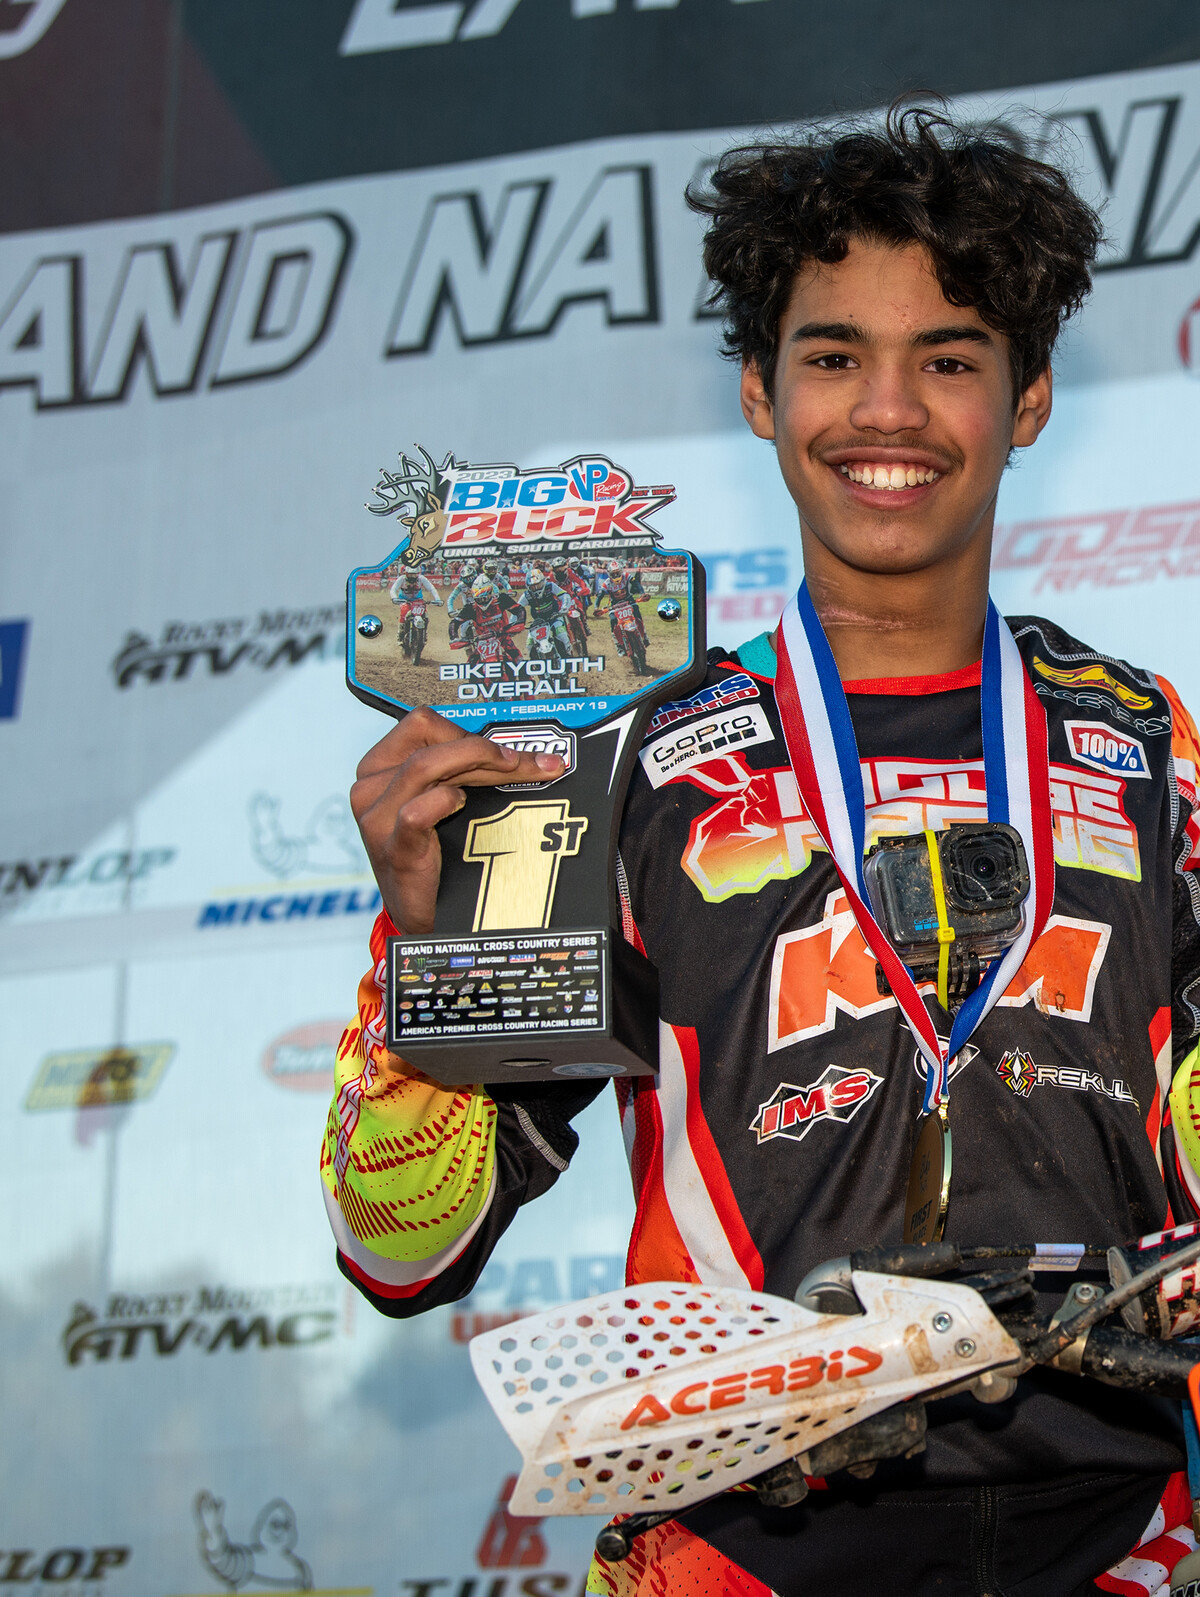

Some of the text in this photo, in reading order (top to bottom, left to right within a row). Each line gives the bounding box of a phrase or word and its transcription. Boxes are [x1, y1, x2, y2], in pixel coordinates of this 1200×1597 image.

[456, 470, 513, 482] 2023
[570, 463, 609, 502] VP
[447, 476, 569, 512] BIG
[444, 502, 652, 544] BUCK
[442, 537, 654, 558] UNION, SOUTH CAROLINA
[535, 626, 548, 641] 3
[438, 656, 604, 681] BIKE YOUTH
[457, 678, 587, 700] OVERALL
[436, 701, 608, 718] ROUND 1 FEBRUARY 19
[660, 764, 671, 774] Be
[674, 750, 699, 766] HERO.
[1077, 731, 1139, 769] 100%
[400, 936, 598, 957] GRAND NATIONAL CROSS COUNTRY SERIES
[400, 1016, 598, 1036] AMERICA'S PREMIER CROSS COUNTRY RACING SERIES
[760, 1073, 872, 1136] IMS
[619, 1344, 884, 1432] ACERBIS
